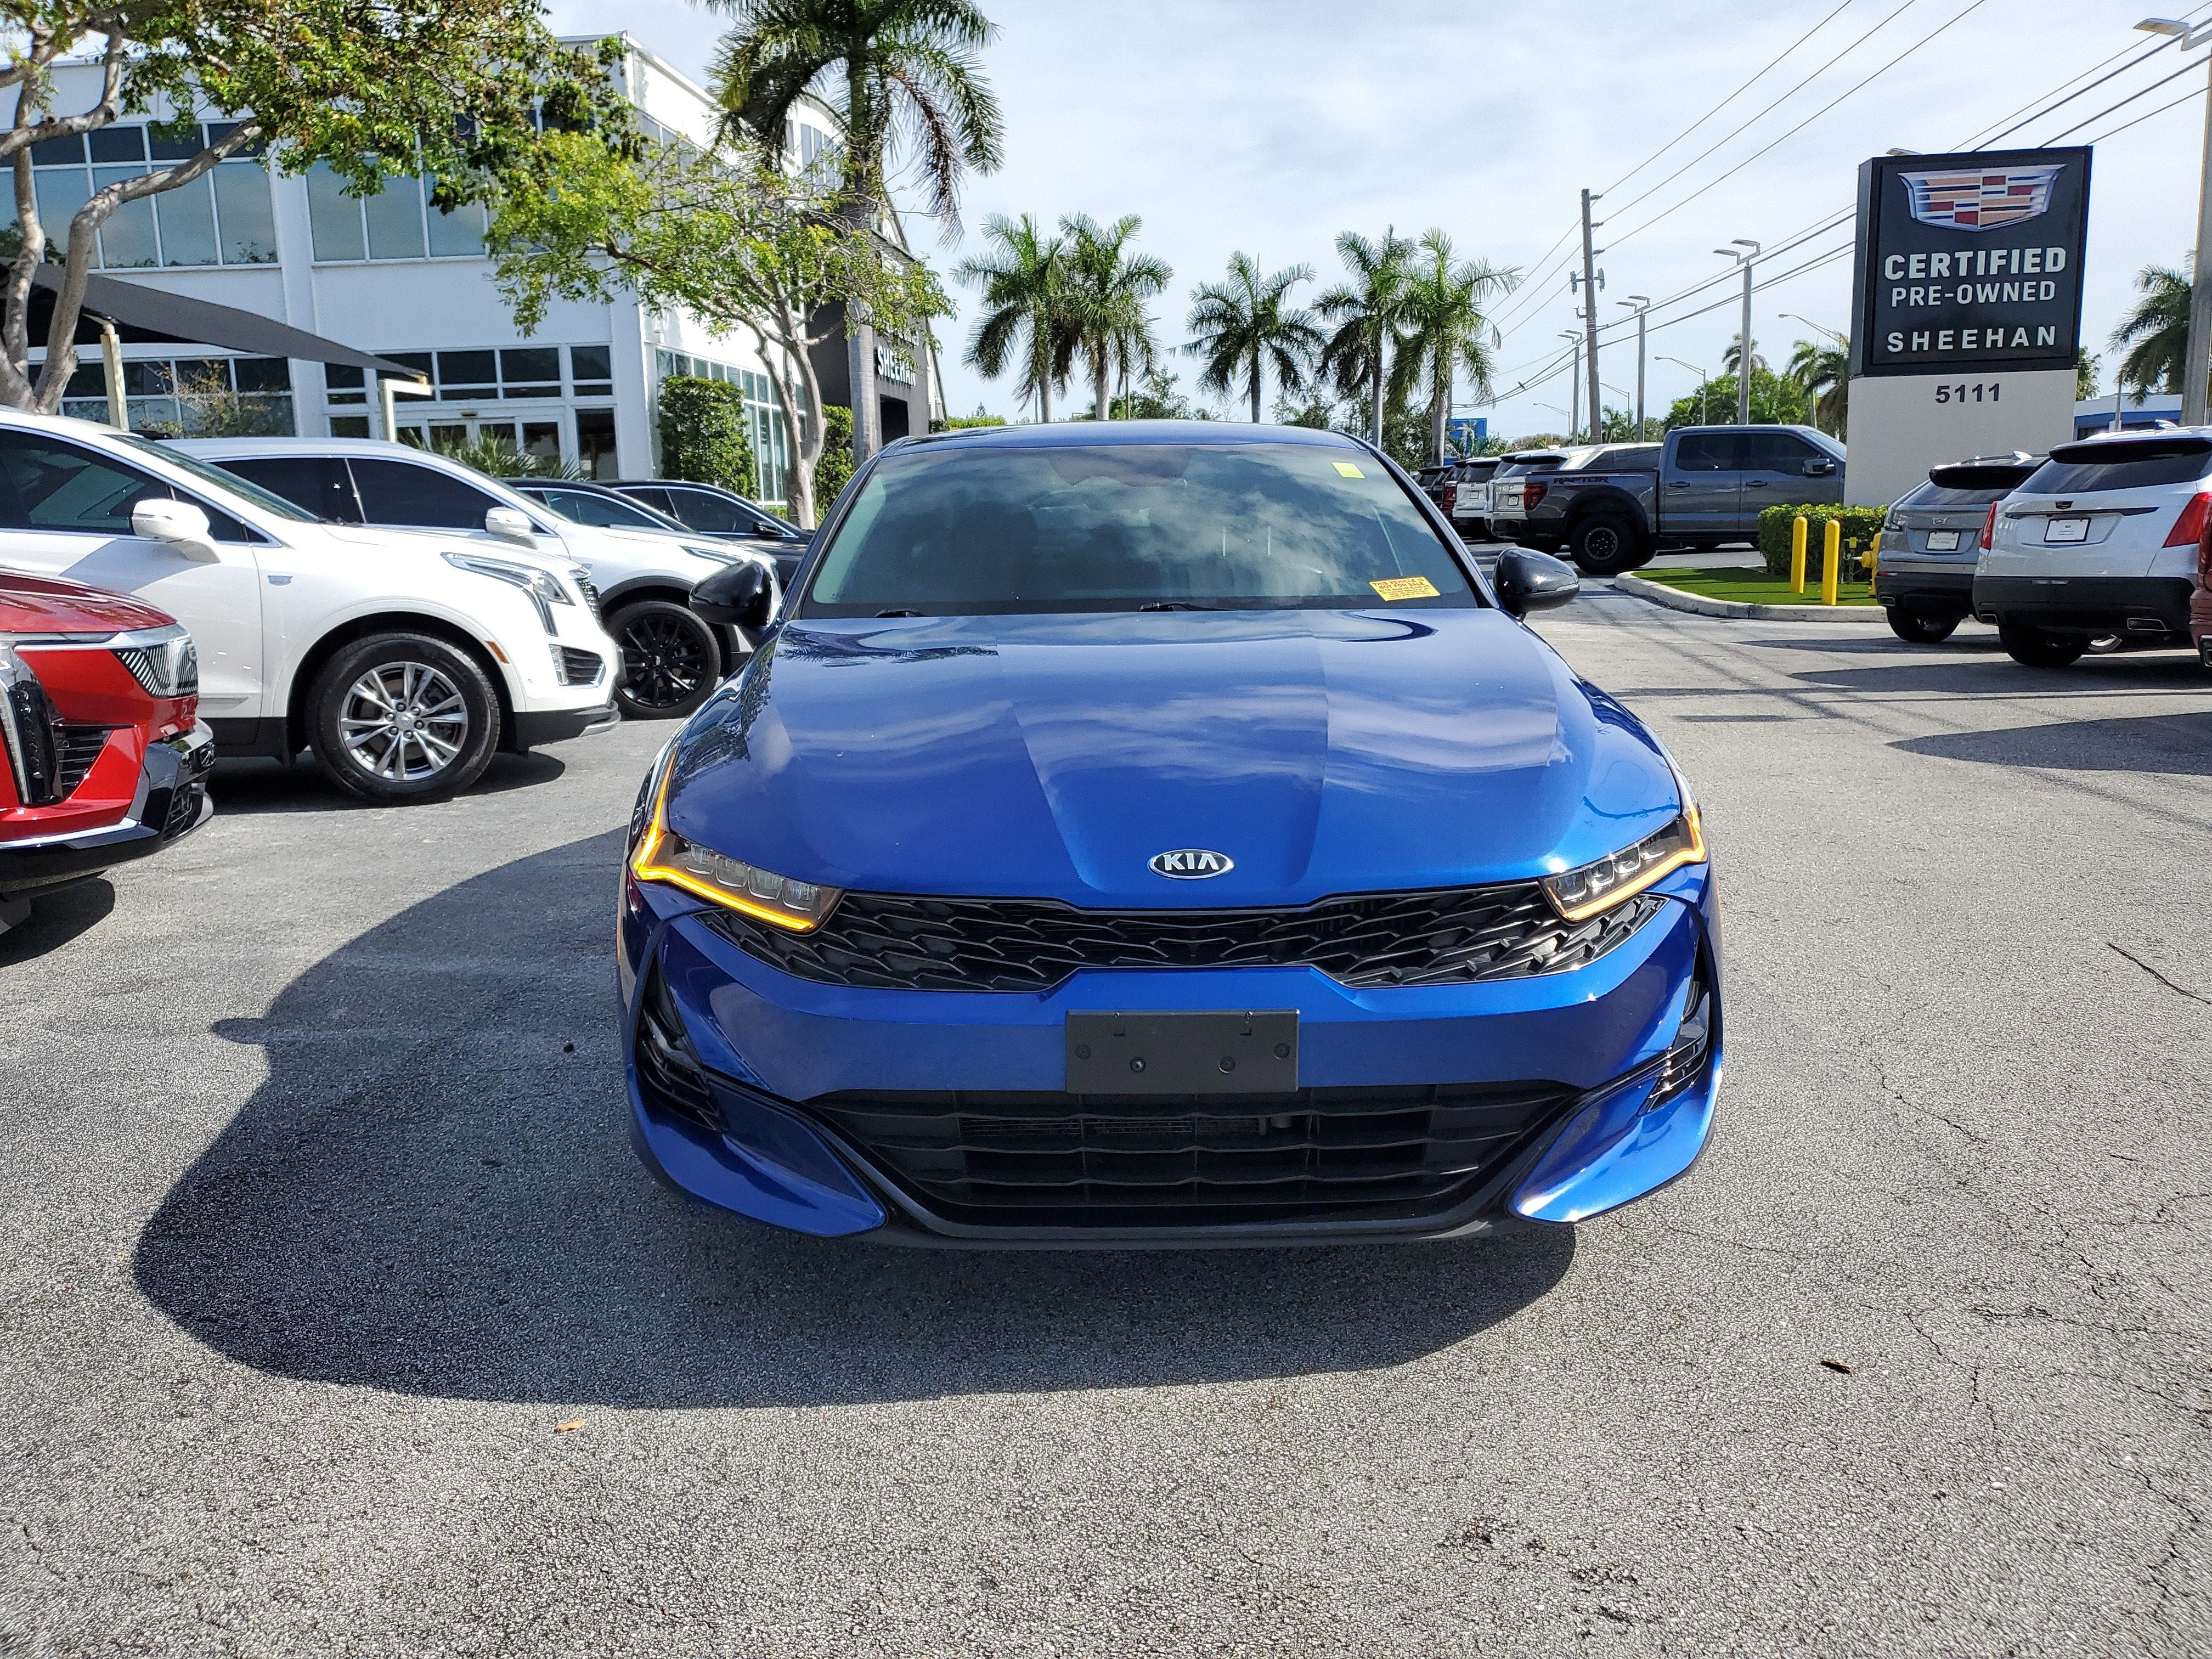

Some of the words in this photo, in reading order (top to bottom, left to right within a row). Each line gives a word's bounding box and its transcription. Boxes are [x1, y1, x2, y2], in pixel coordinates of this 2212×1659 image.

[1884, 247, 2066, 280] CERTIFIED
[1892, 280, 2056, 307] PRE-OWNED
[1887, 326, 2056, 352] SHEEHAN
[1935, 383, 2000, 403] 5111
[1163, 853, 1219, 871] KIA
